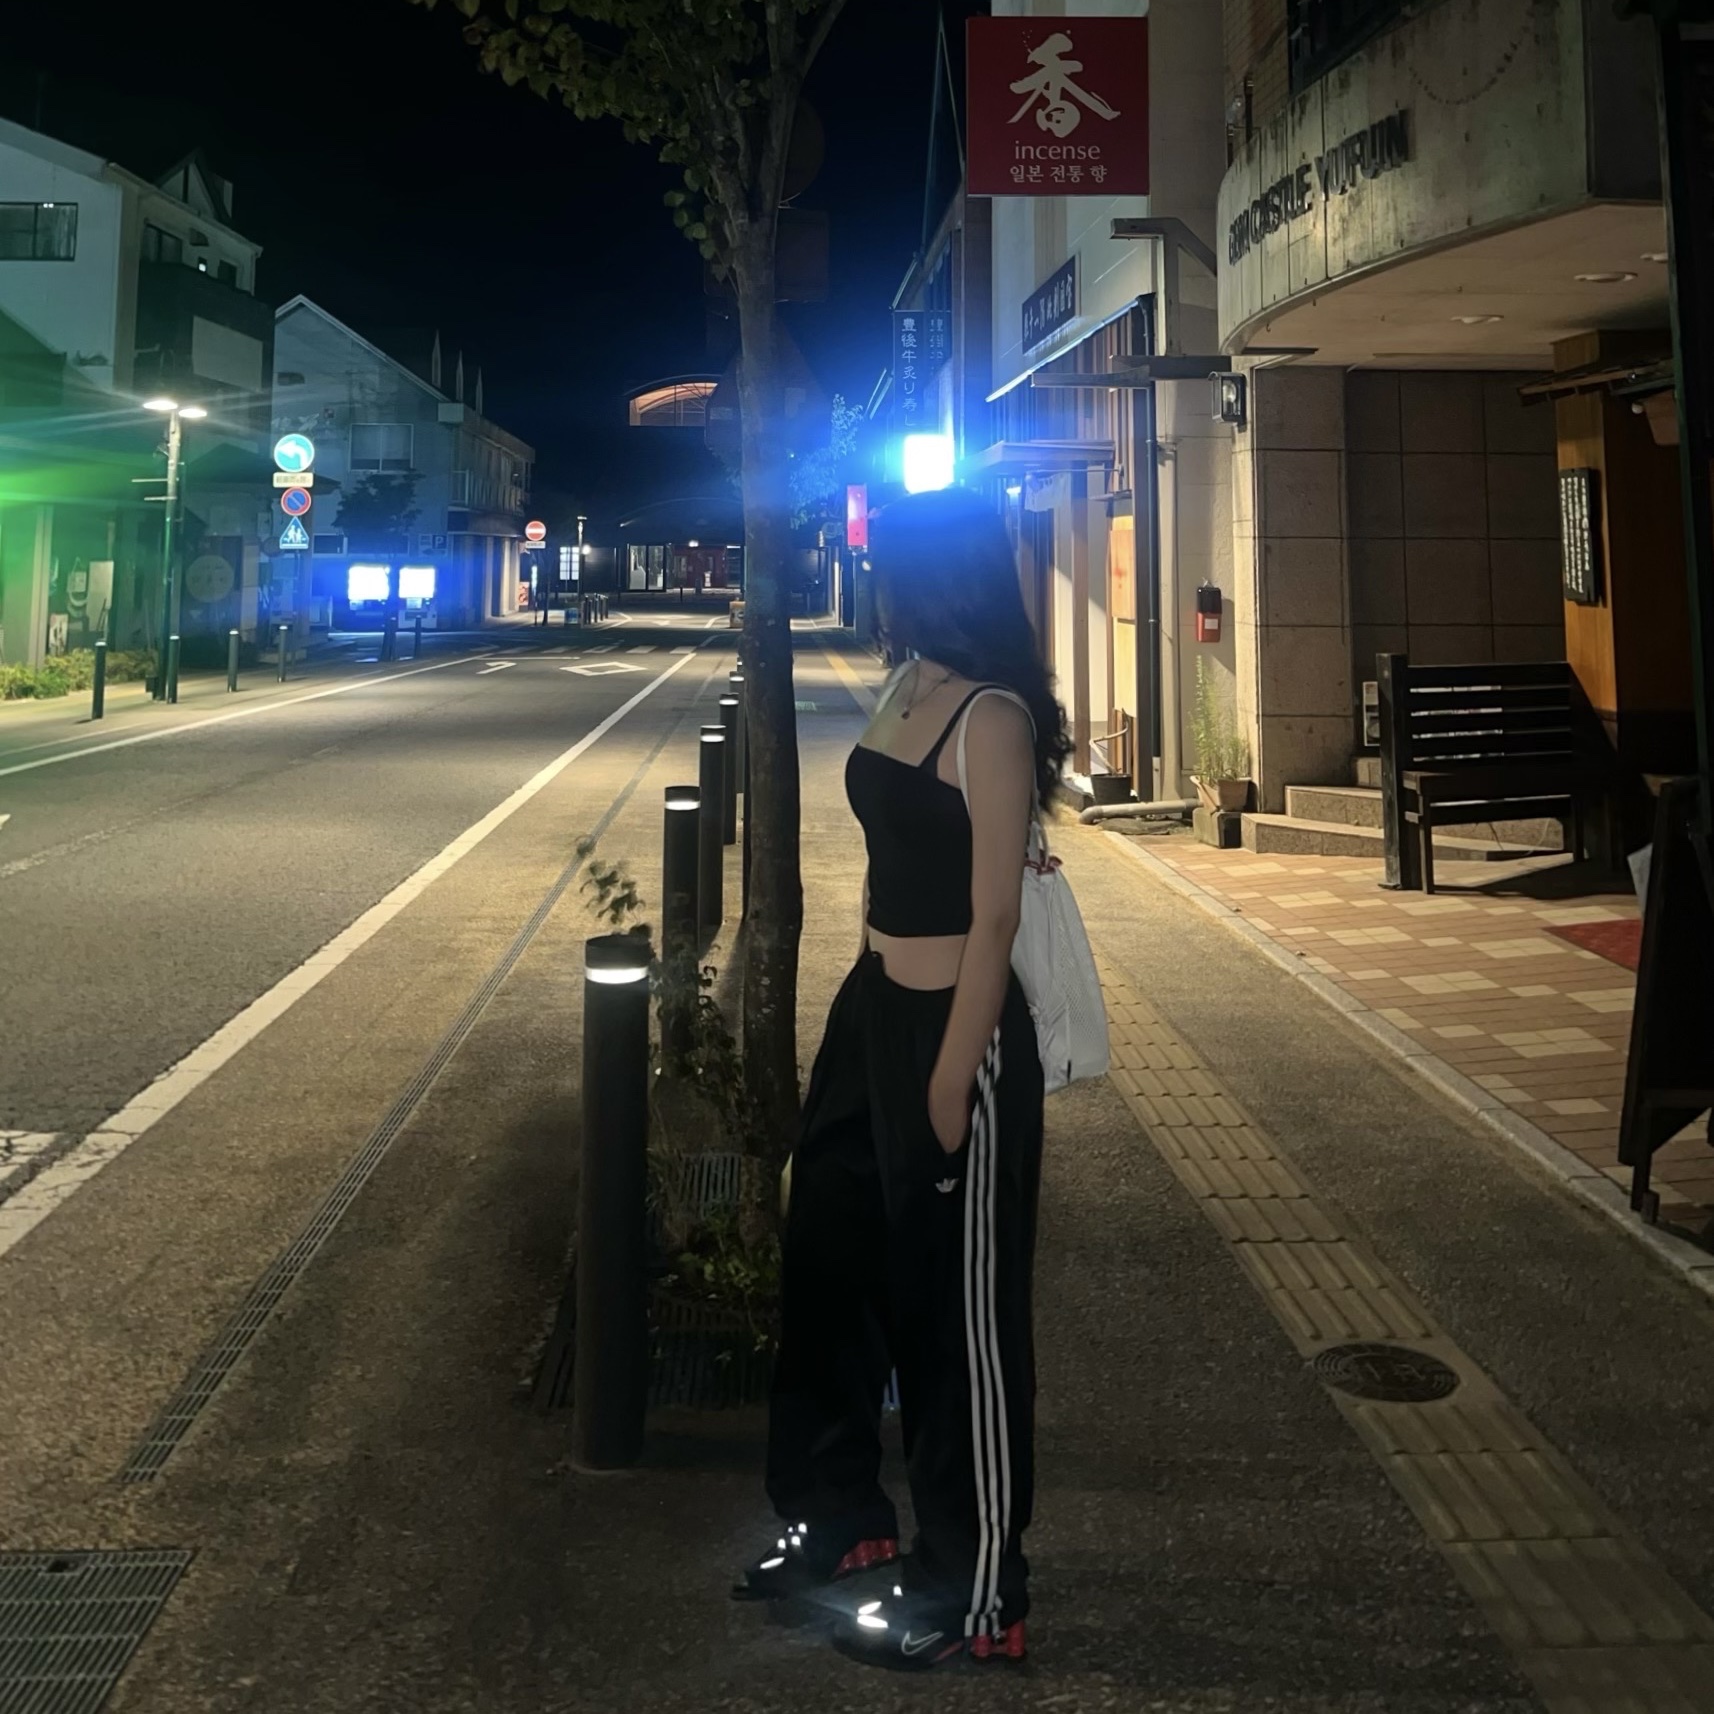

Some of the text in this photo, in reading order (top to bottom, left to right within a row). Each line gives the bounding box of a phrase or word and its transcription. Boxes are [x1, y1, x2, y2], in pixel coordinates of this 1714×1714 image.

[1006, 32, 1121, 138] 香
[1015, 140, 1101, 160] incense
[1009, 165, 1108, 183] 일본 전통 향
[901, 317, 918, 426] 豊後牛炙り寿し
[434, 536, 445, 548] P
